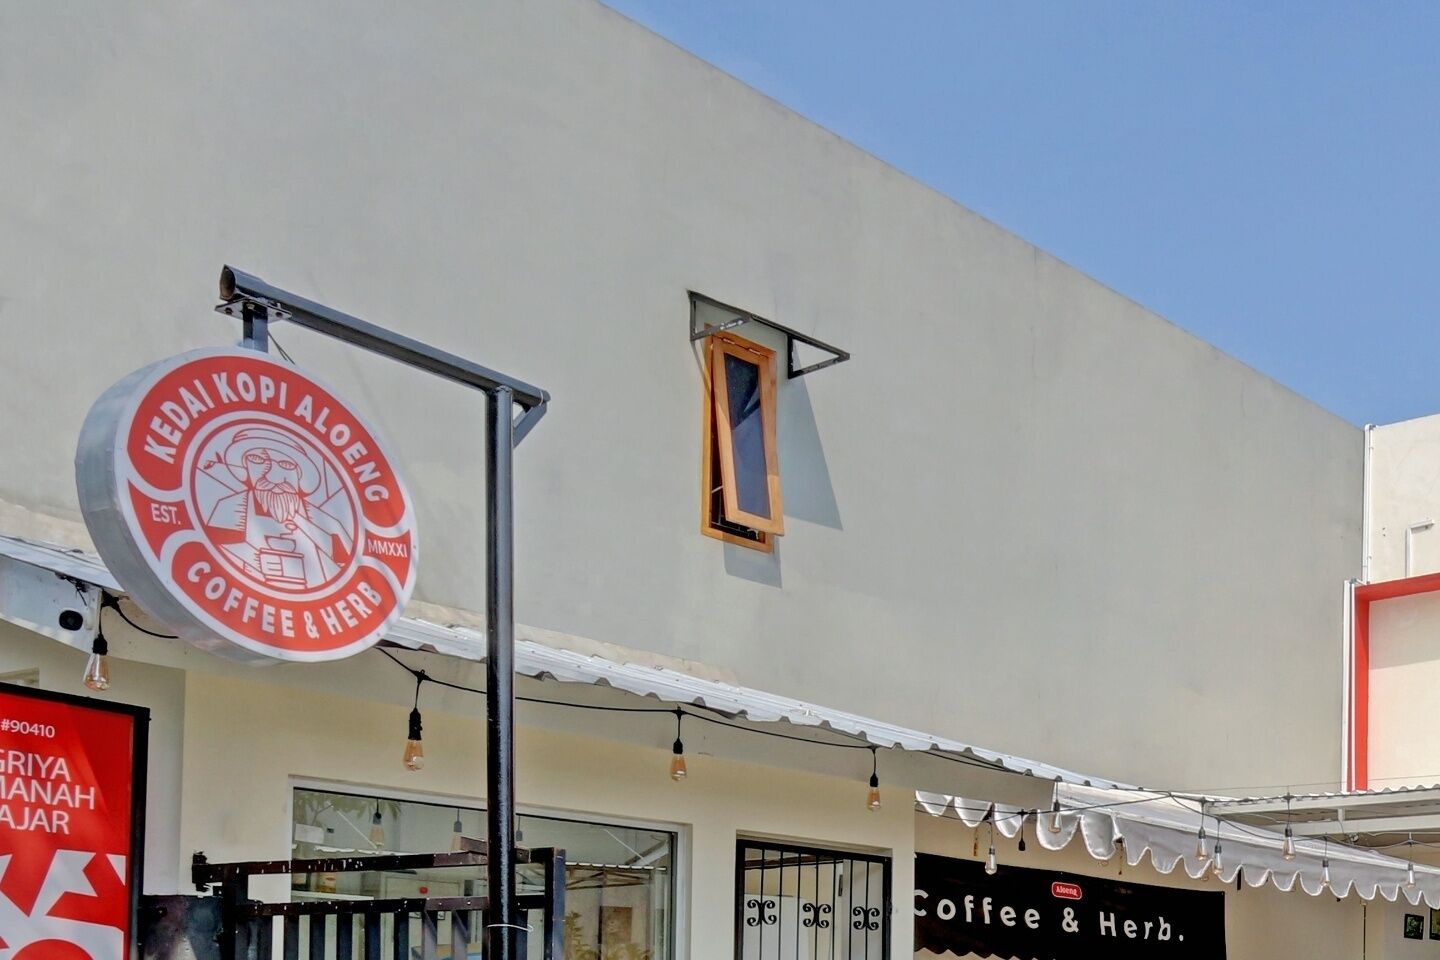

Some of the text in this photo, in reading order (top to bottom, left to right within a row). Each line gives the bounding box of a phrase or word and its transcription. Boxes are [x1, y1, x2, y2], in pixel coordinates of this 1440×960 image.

[144, 372, 390, 502] KEDAI KOPI ALOENG
[151, 503, 181, 525] EST.
[367, 539, 409, 558] MMXXI
[187, 561, 383, 639] COFFEE & HERB
[1, 718, 55, 738] #90410
[0, 749, 71, 782] RIYA
[1061, 907, 1080, 934] &
[1099, 911, 1185, 942] Herb.
